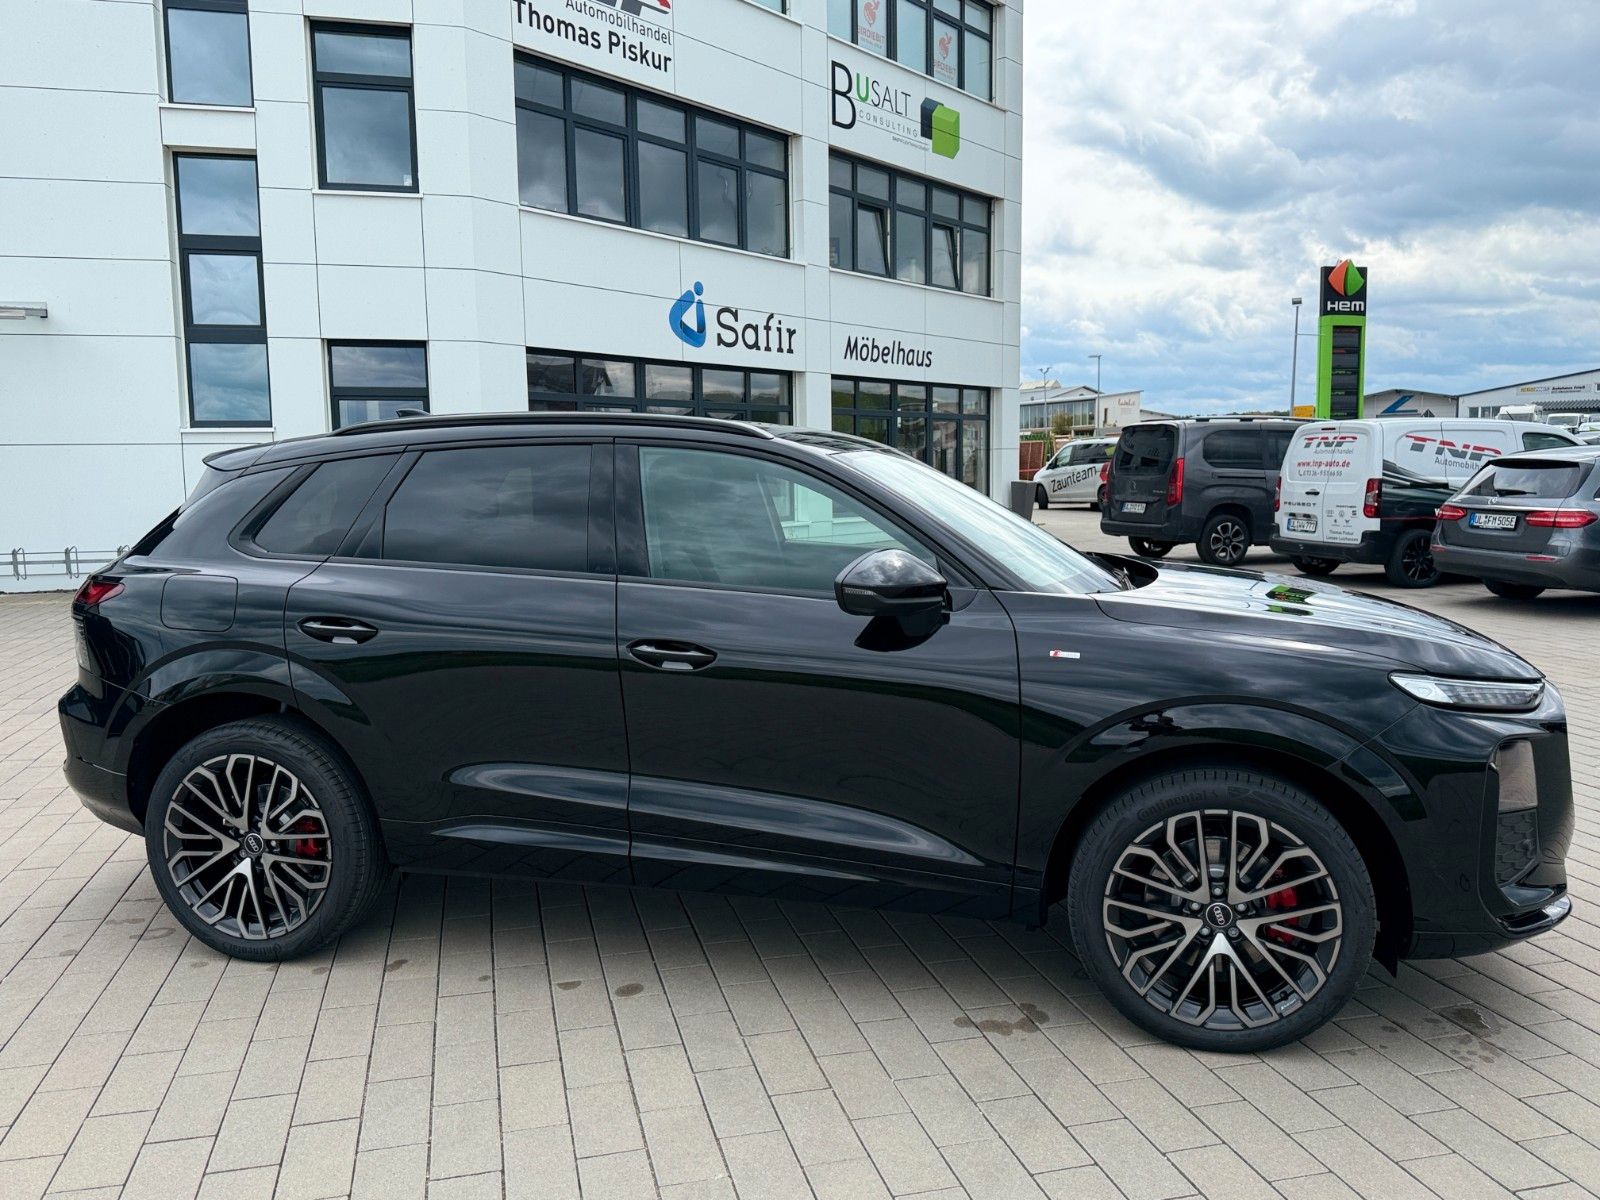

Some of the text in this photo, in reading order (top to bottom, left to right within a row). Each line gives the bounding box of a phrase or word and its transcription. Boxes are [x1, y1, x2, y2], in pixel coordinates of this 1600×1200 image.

[512, 0, 672, 73] Thomas Piskur
[566, 0, 672, 46] Automobilhandel
[831, 59, 912, 130] BUSALT
[858, 109, 919, 138] CONSULTING
[716, 306, 797, 354] Safir
[843, 335, 933, 368] Möbelhaus
[1304, 436, 1358, 448] TNP
[1405, 434, 1502, 462] TNP
[1050, 466, 1097, 493] Zaunteam
[1297, 460, 1351, 468] www.tnp-auto.de
